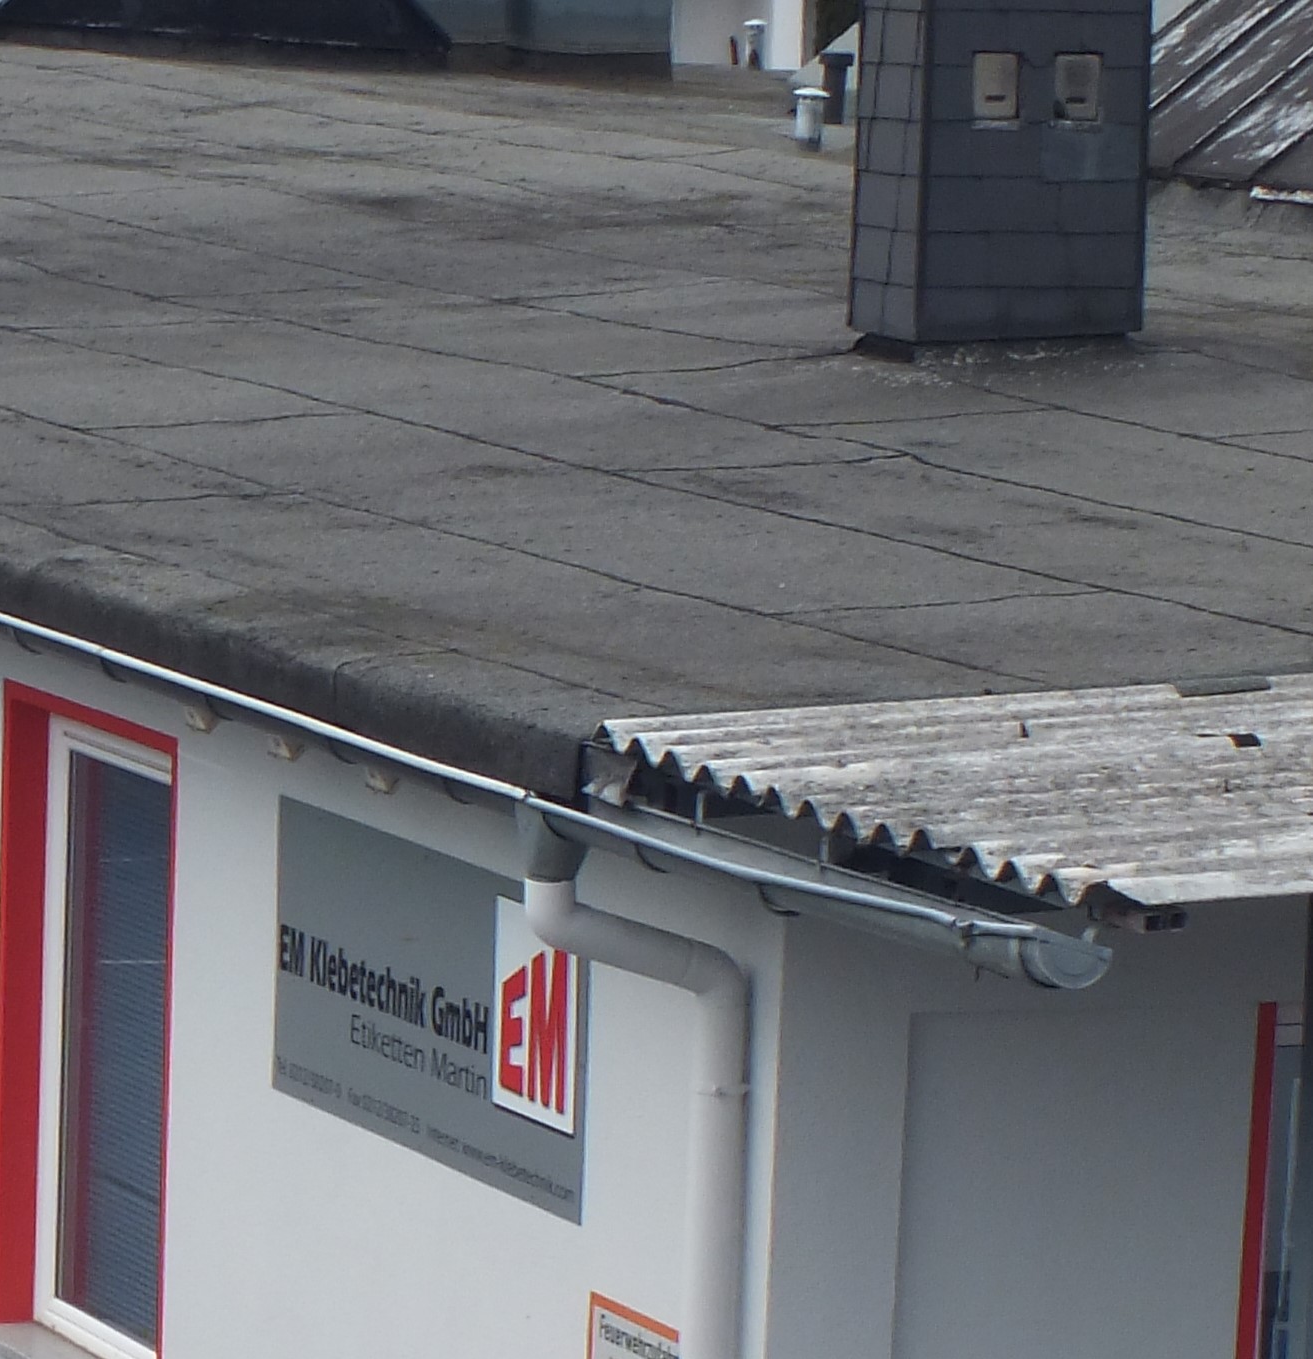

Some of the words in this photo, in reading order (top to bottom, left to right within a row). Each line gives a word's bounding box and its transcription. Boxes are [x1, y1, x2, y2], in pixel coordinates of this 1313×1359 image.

[278, 923, 306, 978] EM
[309, 935, 427, 1029] Klebetechnik
[431, 985, 489, 1055] GmbH
[498, 948, 569, 1116] EM
[349, 1013, 425, 1073] Etiketten
[430, 1047, 488, 1101] Martin
